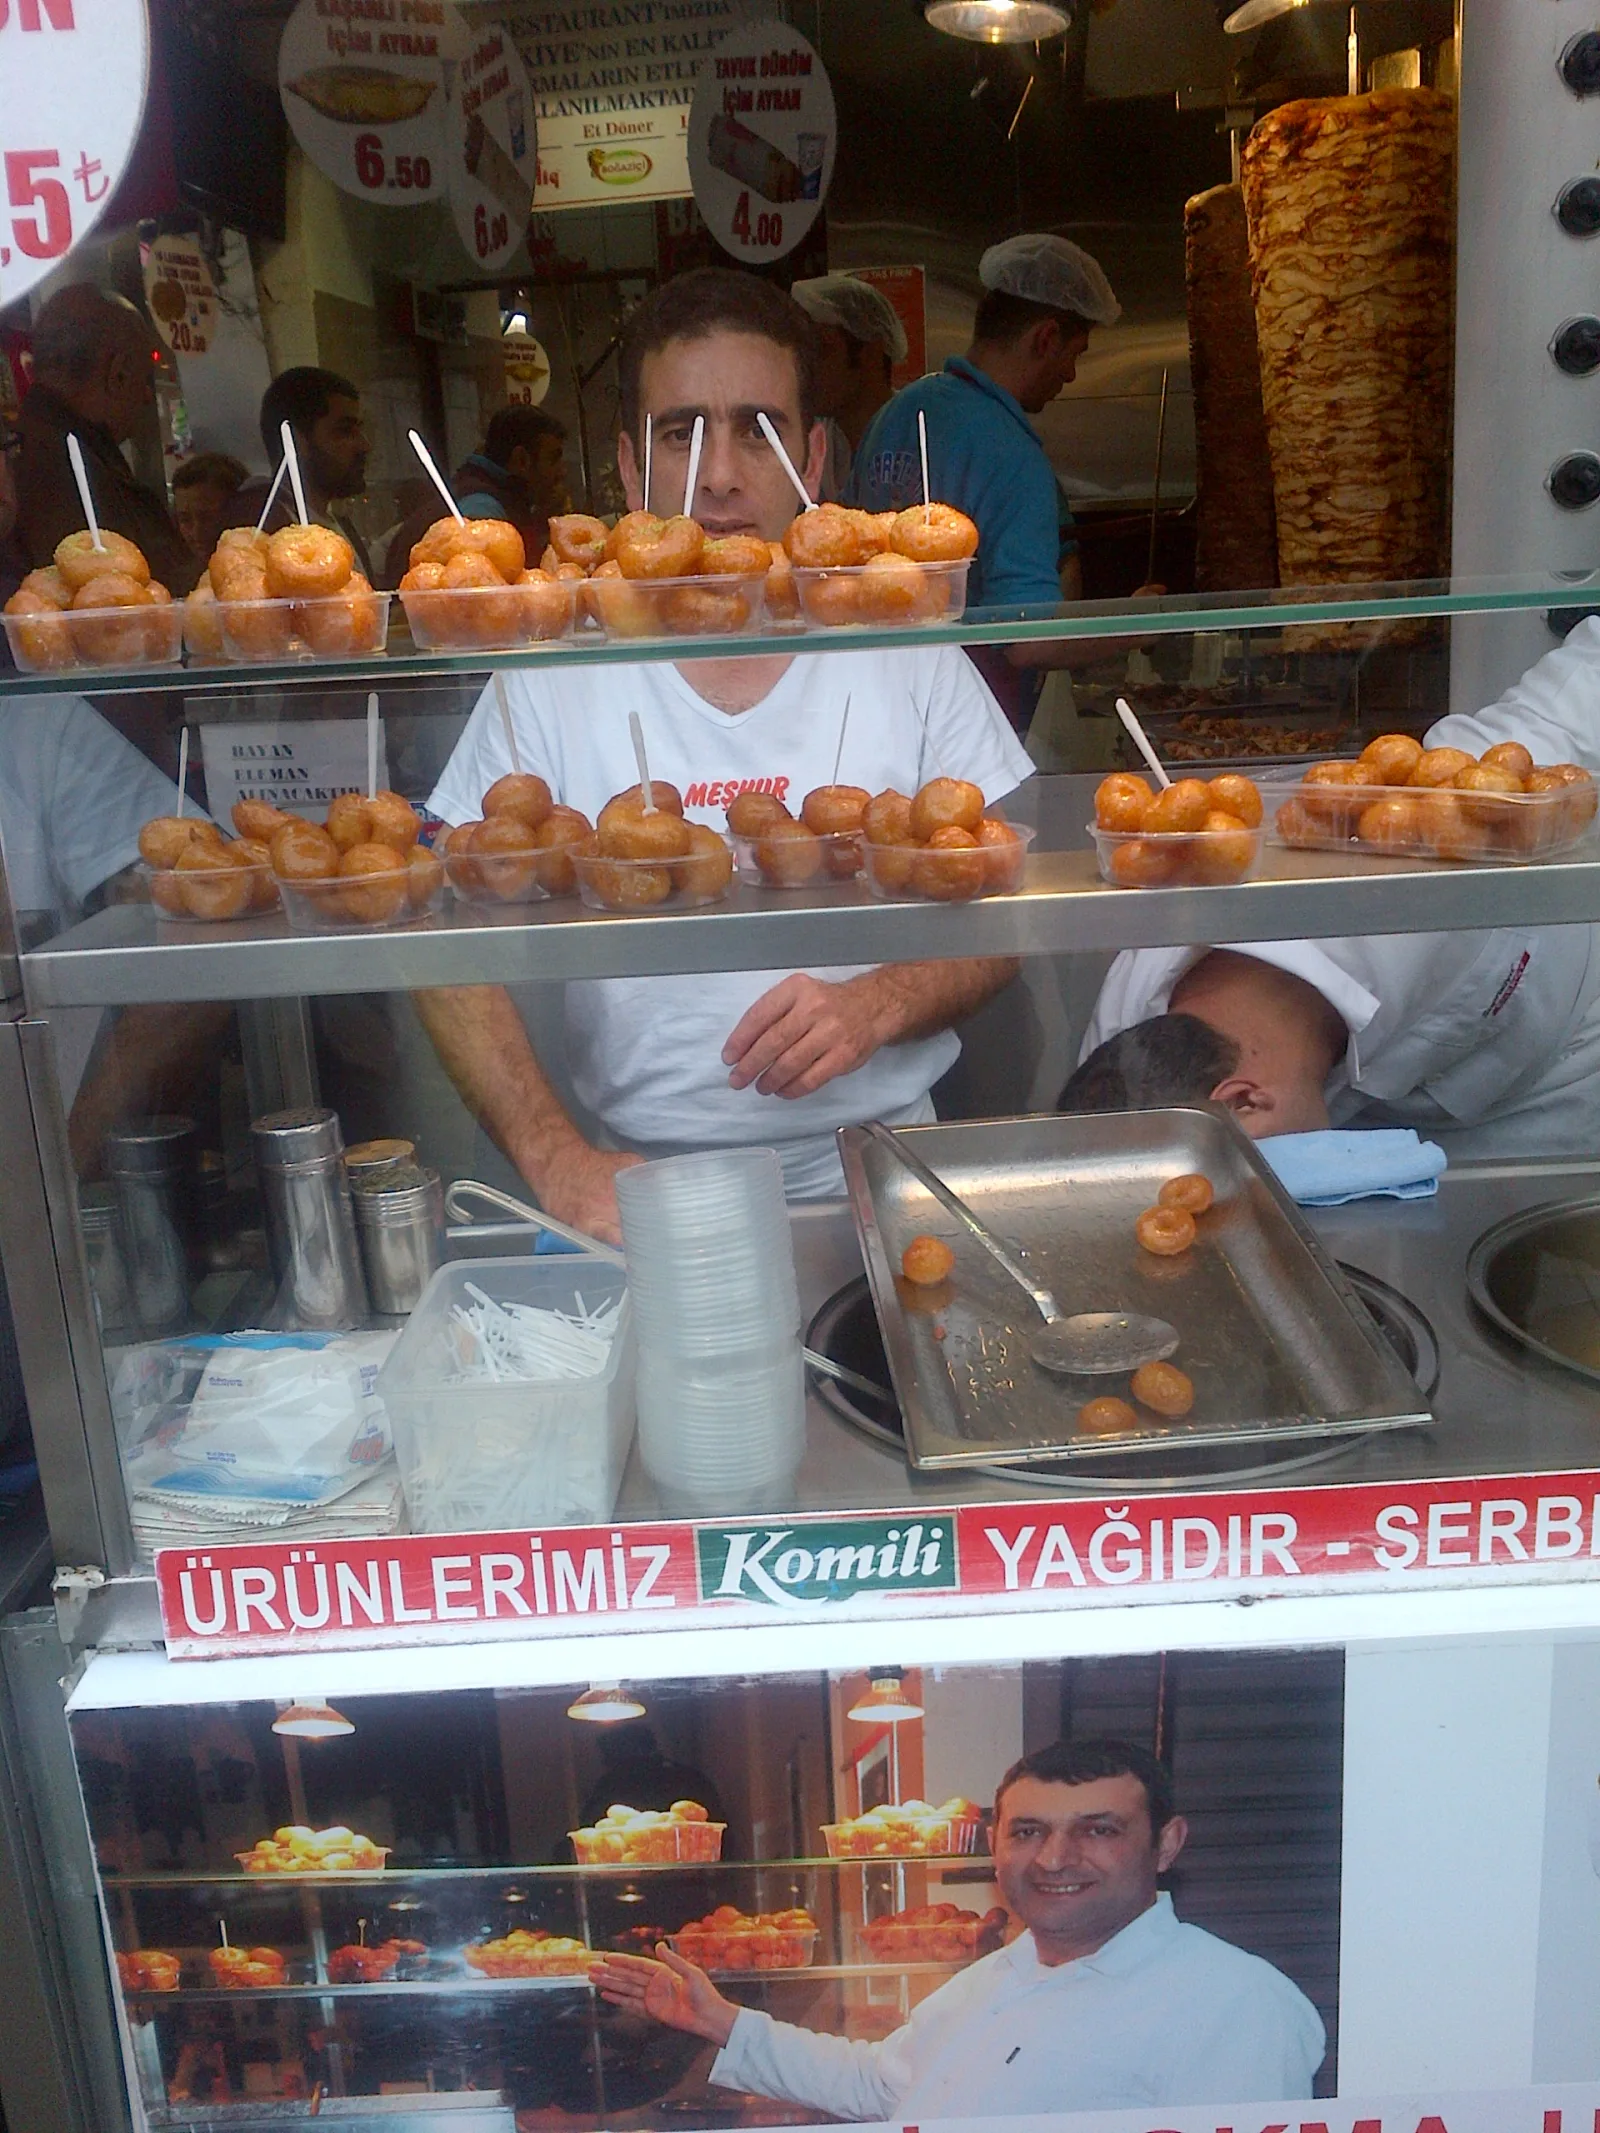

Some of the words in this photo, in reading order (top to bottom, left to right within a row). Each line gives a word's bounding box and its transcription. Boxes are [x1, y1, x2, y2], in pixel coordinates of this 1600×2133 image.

[583, 123, 600, 139] Et
[605, 120, 654, 137] Döner
[354, 133, 431, 189] 6.50
[731, 191, 783, 246] 4.00
[232, 744, 293, 757] BAYAN
[235, 768, 308, 780] ELEMAN
[179, 1532, 676, 1635] ÜRÜNLERİMİZ
[713, 1525, 943, 1608] Komili
[984, 1505, 1301, 1590] YAĞIDIR
